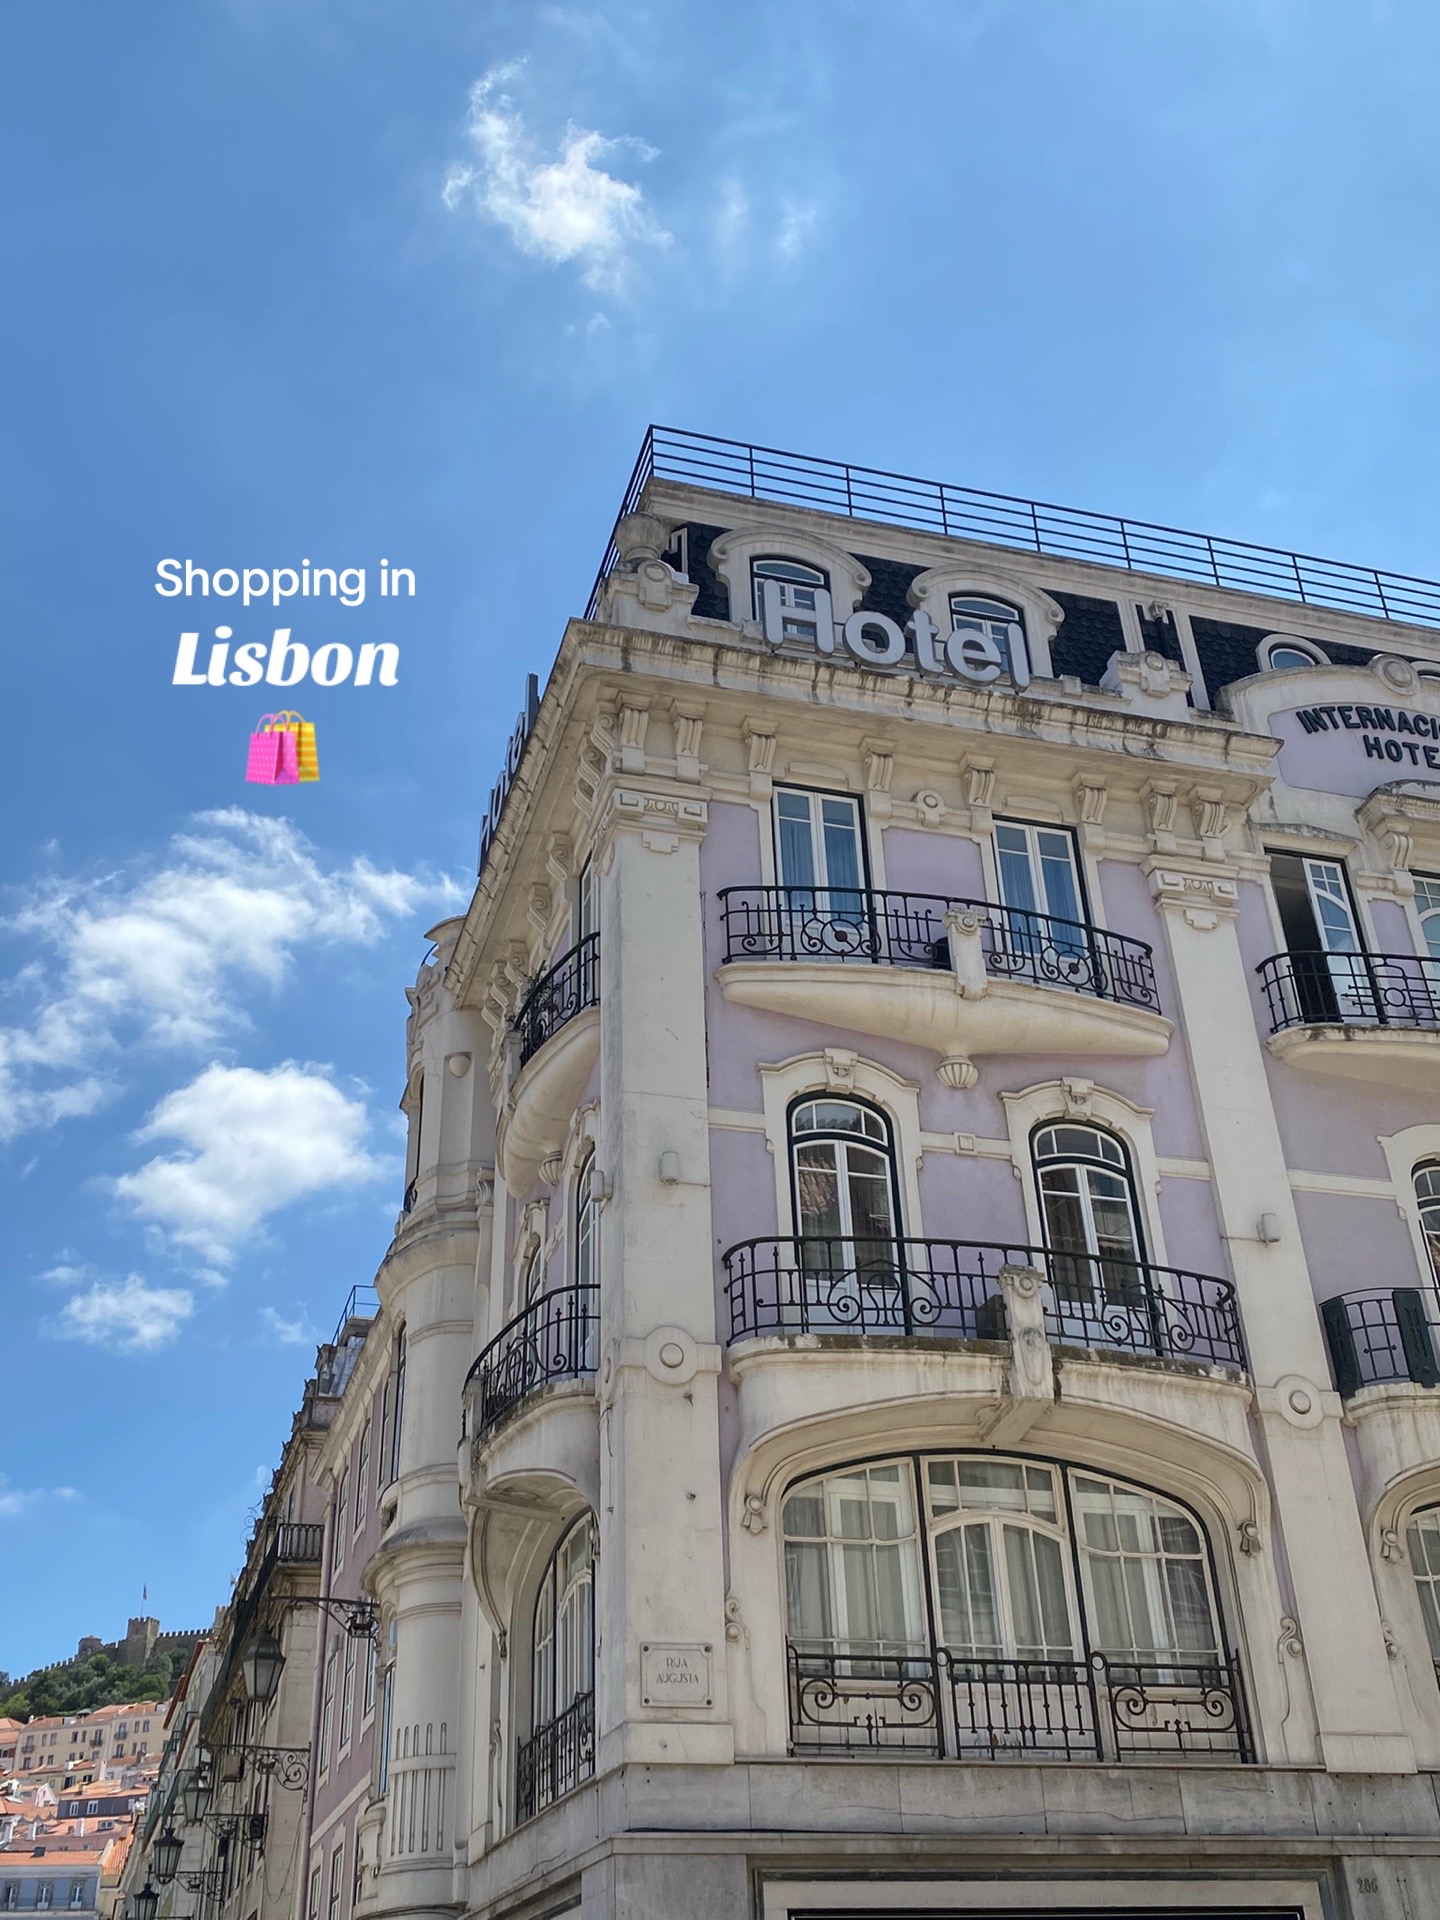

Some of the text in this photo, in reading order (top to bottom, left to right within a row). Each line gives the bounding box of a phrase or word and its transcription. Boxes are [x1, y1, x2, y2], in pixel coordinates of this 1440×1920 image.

[762, 578, 1031, 694] Hotel
[1295, 705, 1440, 740] INTERNACI
[666, 1657, 688, 1668] RUA
[656, 1673, 700, 1684] AUGUSTA
